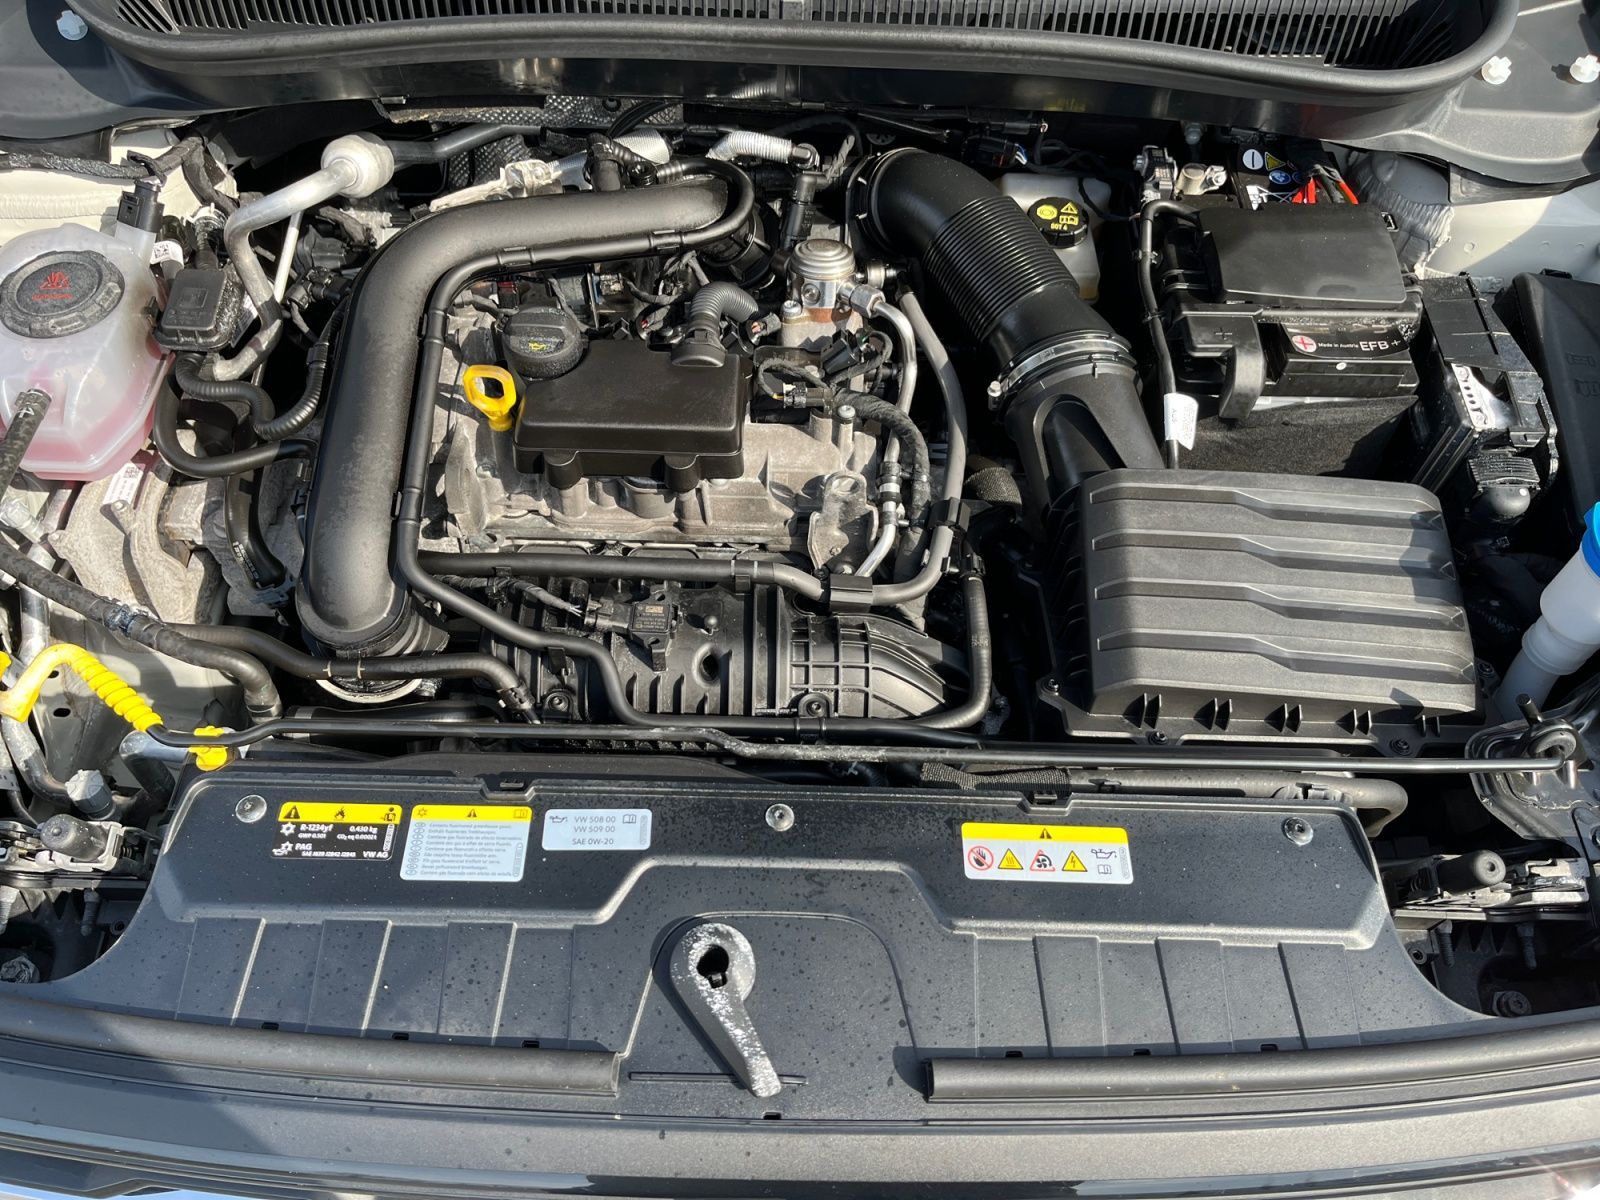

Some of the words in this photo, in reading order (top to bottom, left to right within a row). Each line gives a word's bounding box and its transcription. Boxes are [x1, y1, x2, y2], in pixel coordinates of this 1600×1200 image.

[1359, 340, 1389, 351] EFB
[300, 824, 334, 832] R-1234yf
[368, 826, 379, 834] kg
